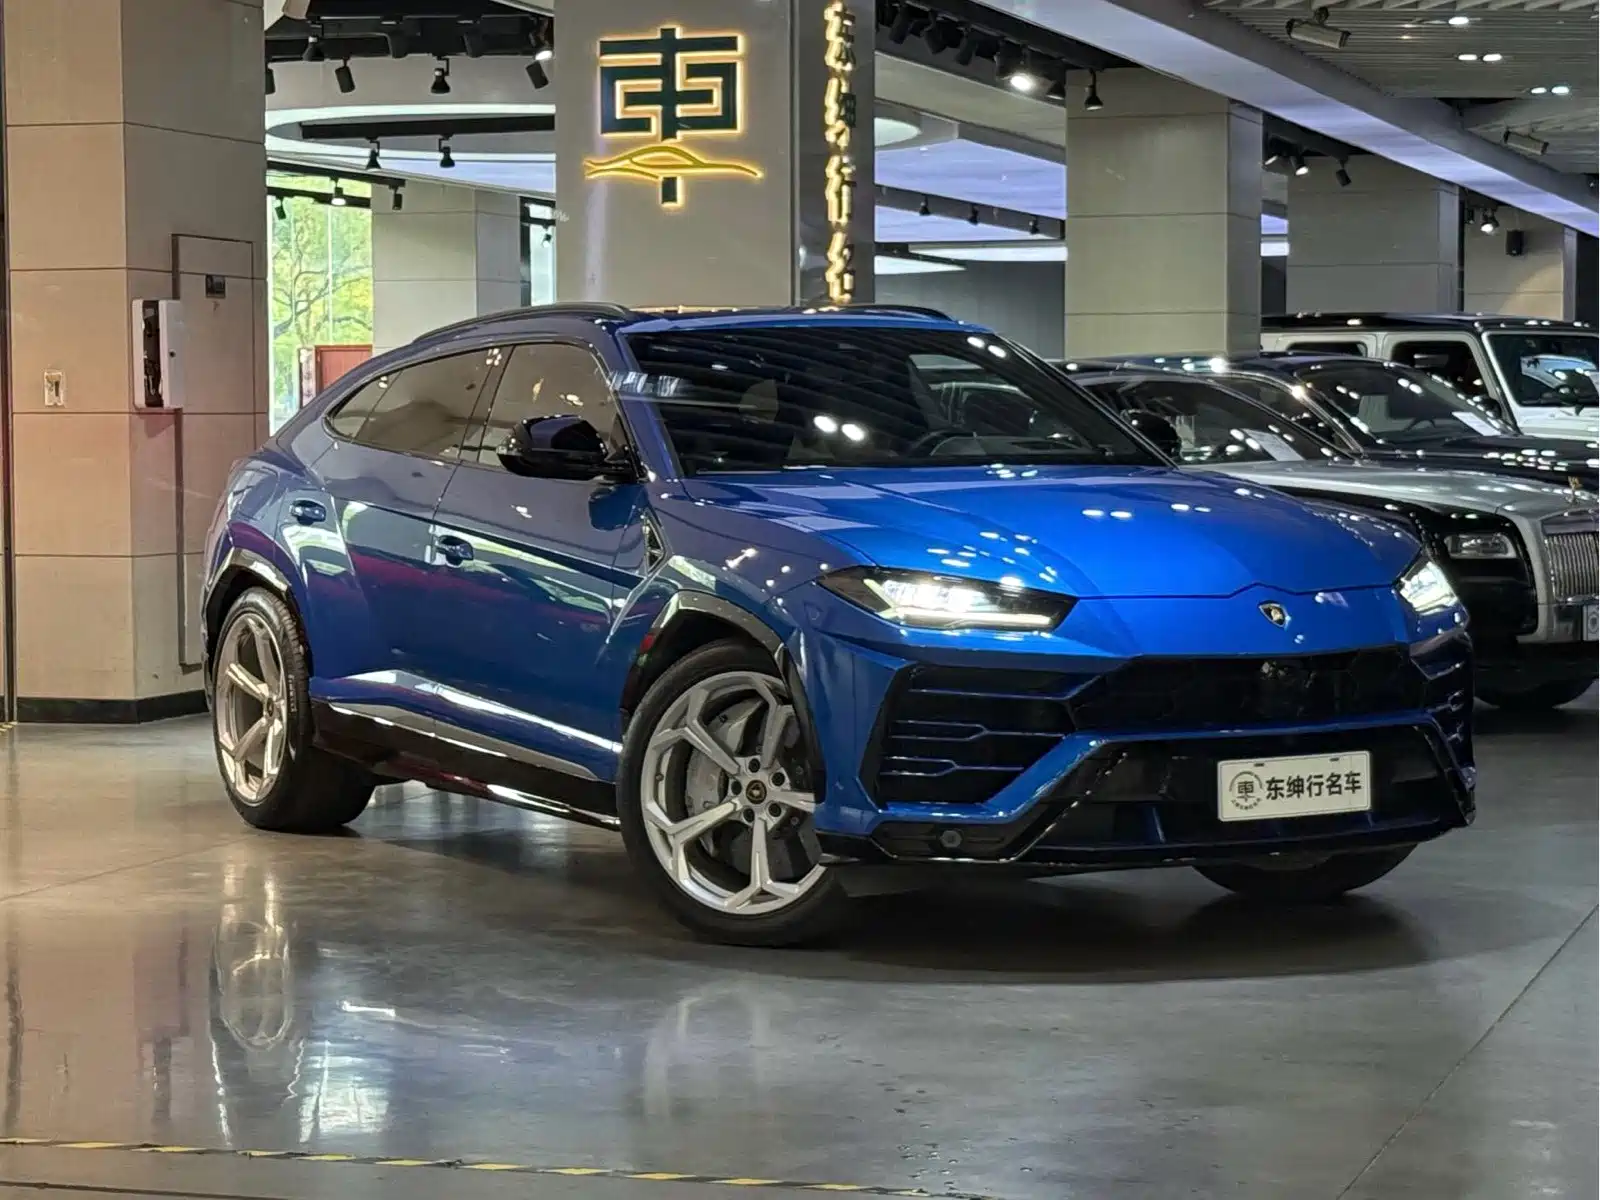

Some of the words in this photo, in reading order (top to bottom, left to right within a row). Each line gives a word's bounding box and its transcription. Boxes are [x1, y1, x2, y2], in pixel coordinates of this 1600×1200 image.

[1265, 770, 1362, 801] 东绅行名车
